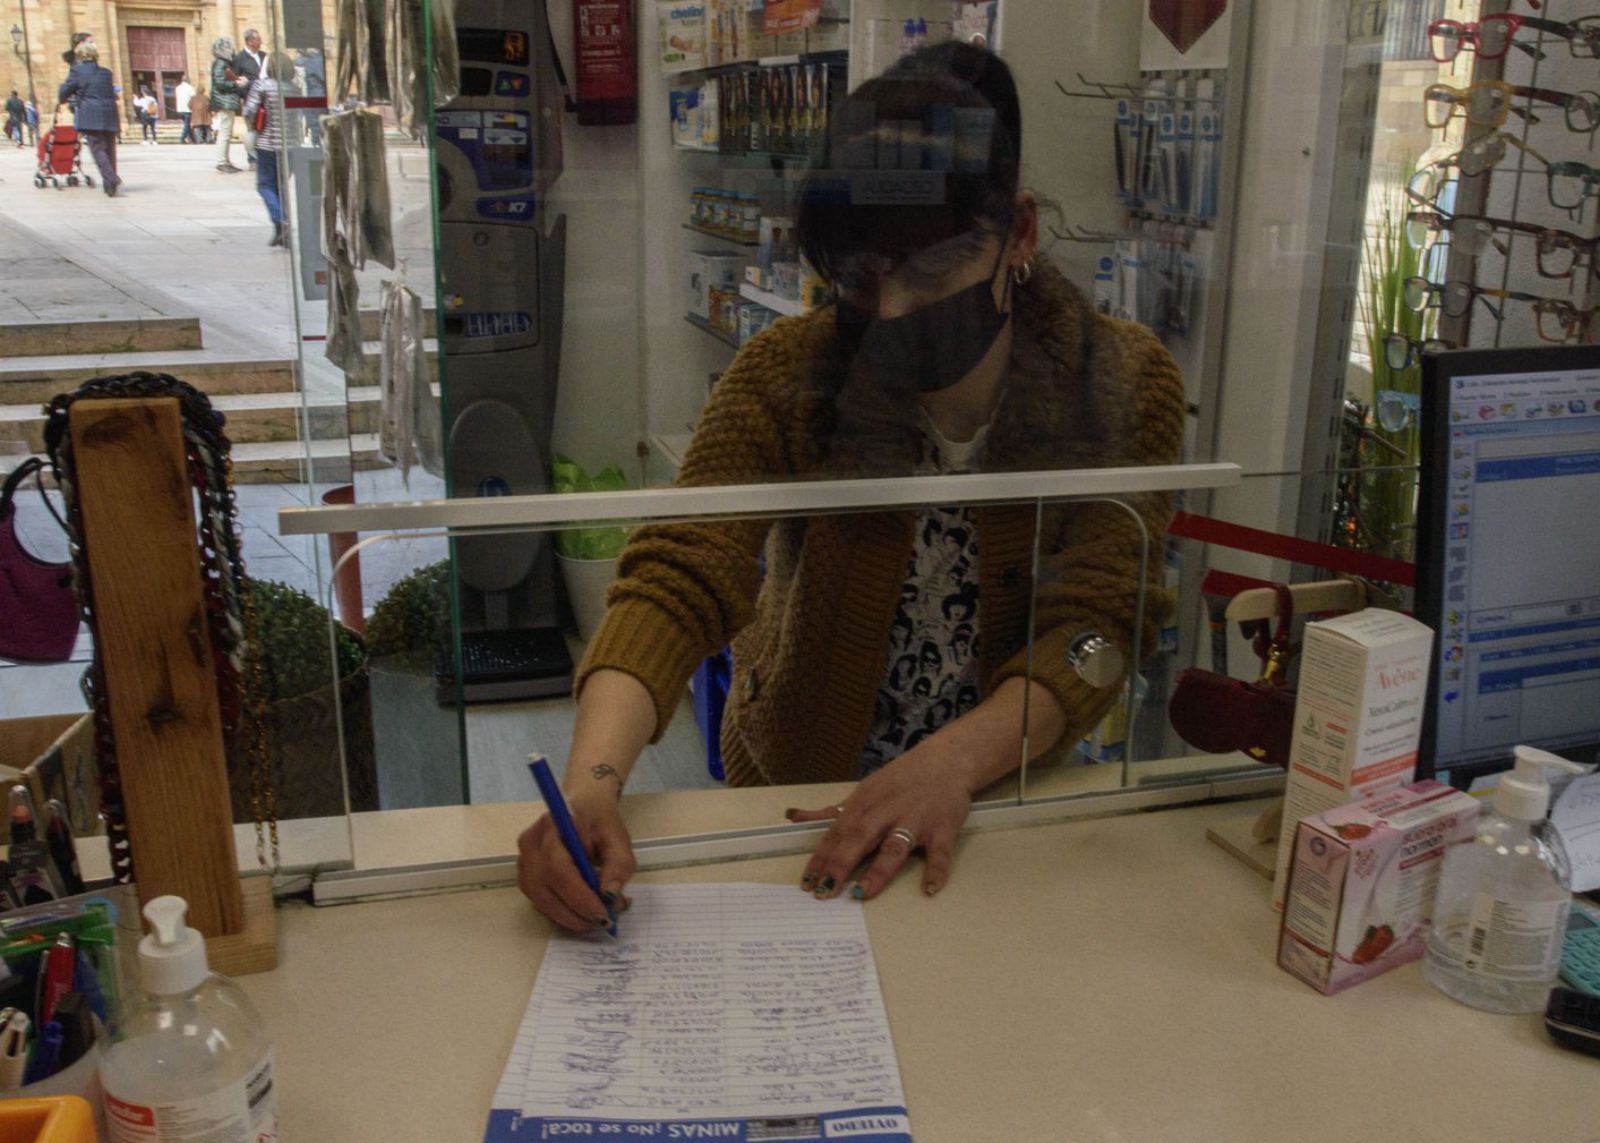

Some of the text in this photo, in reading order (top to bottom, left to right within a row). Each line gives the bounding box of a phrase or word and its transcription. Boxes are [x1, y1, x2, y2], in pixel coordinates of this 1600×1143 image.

[508, 201, 527, 213] K7
[1379, 666, 1421, 690] Avène
[541, 1122, 593, 1139] toca!
[598, 1122, 622, 1133] se
[668, 1122, 739, 1137] MINAS
[832, 1117, 898, 1132] OVIEDO
